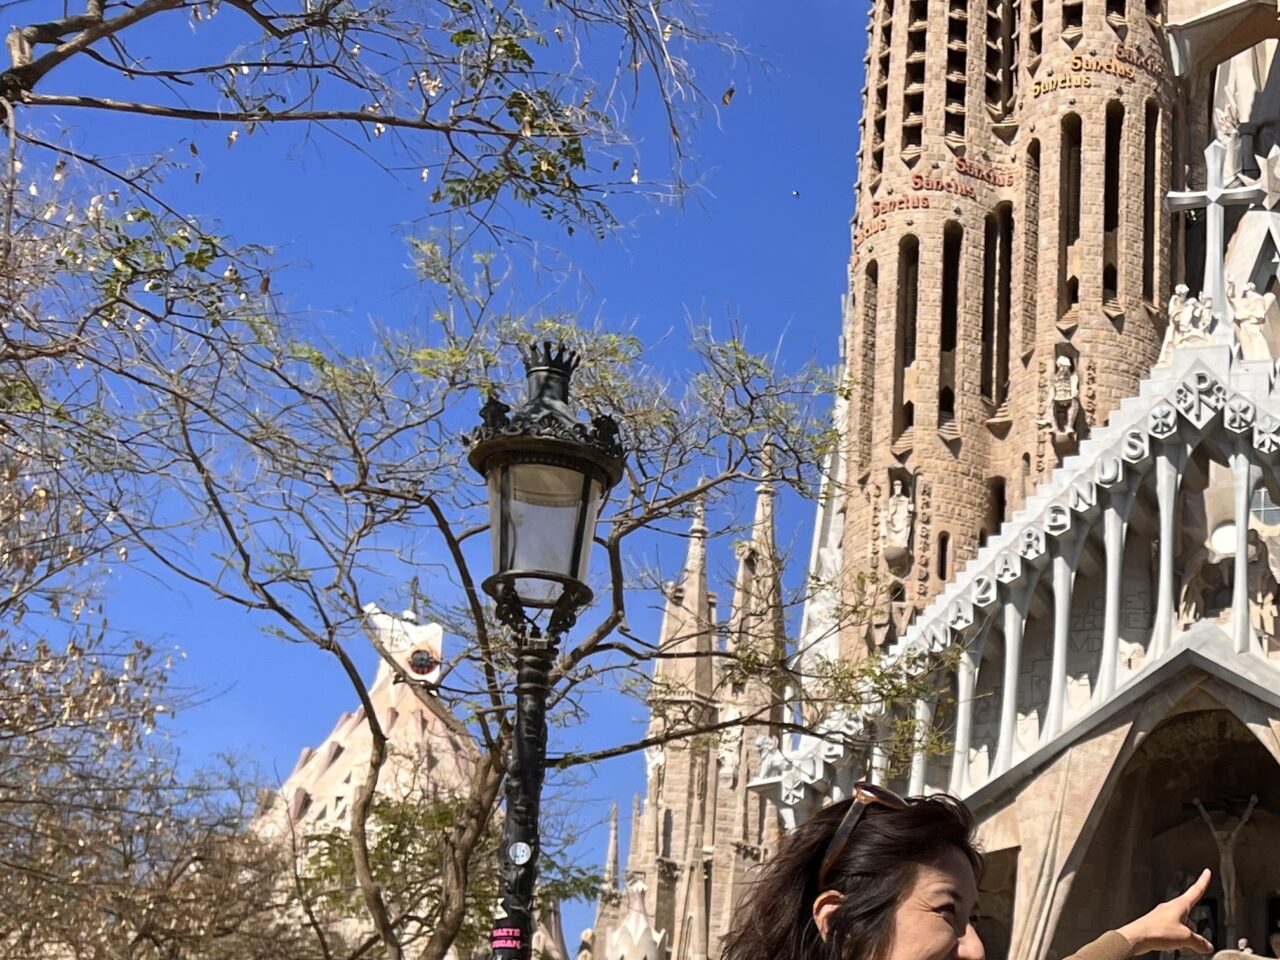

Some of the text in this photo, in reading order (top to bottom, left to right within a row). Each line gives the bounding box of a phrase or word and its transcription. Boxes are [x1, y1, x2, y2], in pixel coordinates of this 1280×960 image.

[1071, 56, 1136, 82] Sanctus
[1032, 73, 1092, 98] Sanctus
[912, 174, 977, 202] Sanctus
[925, 430, 1147, 652] NAZARENUS
